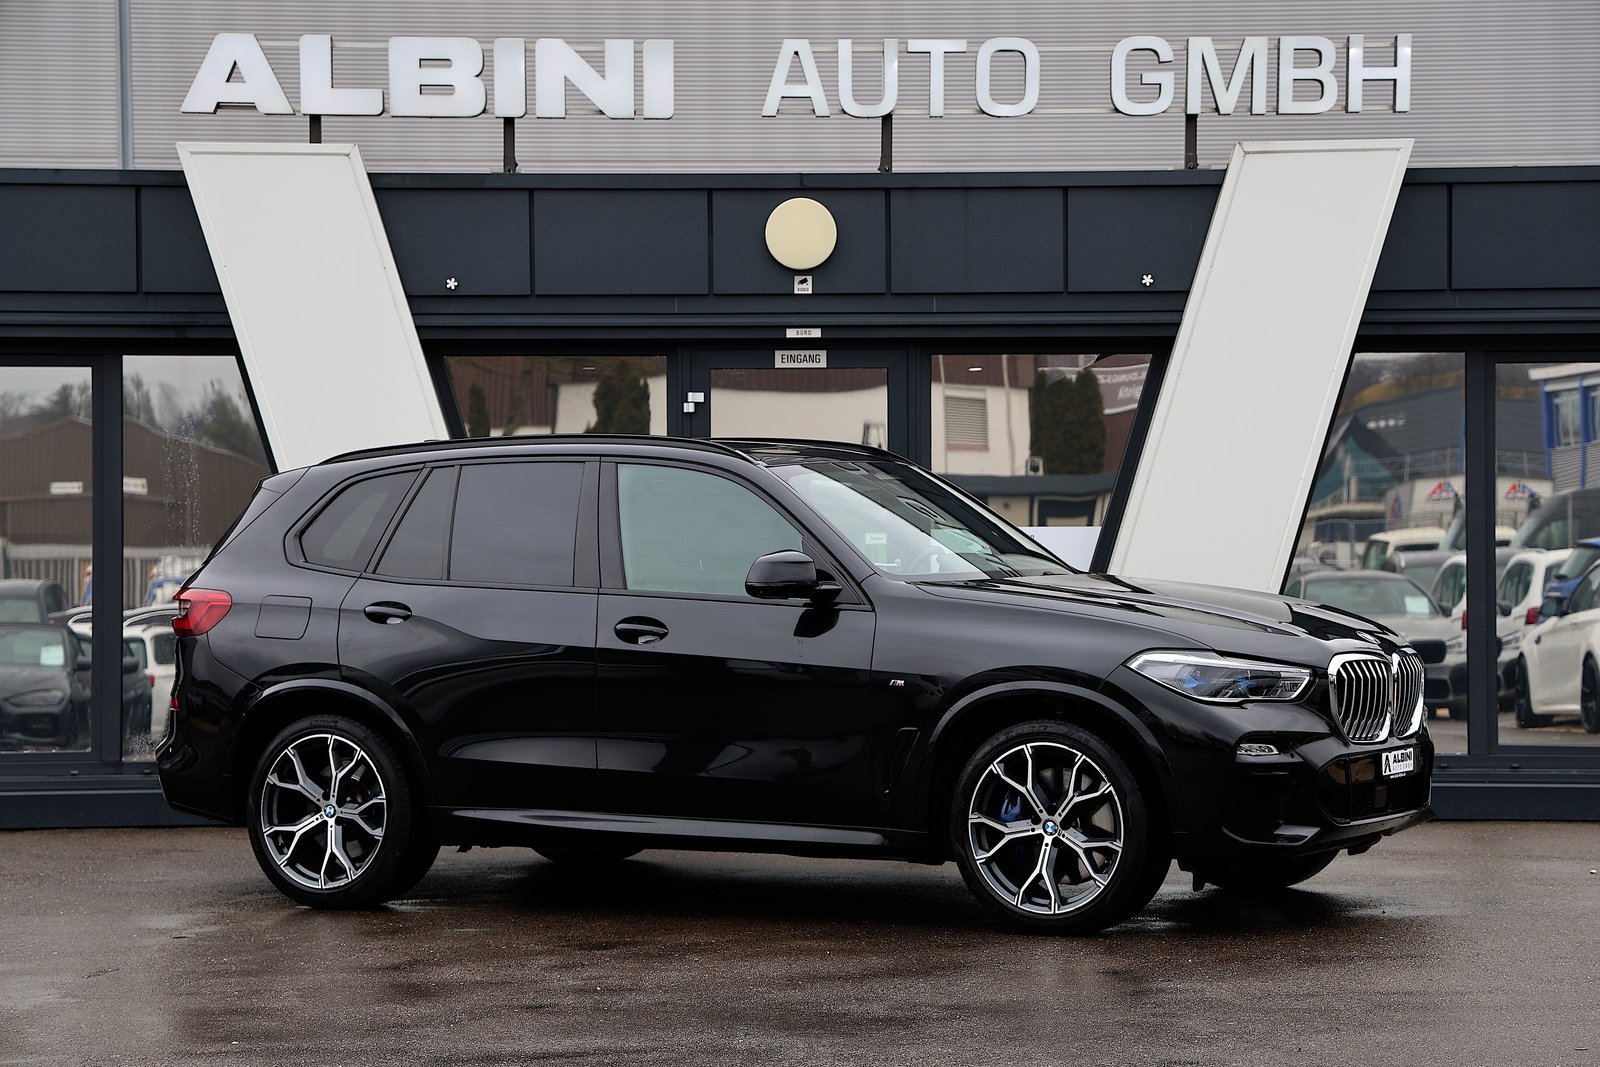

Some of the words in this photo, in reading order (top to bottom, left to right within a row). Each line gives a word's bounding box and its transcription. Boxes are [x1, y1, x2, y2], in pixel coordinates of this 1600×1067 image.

[180, 32, 675, 120] ALBINI
[761, 36, 1041, 118] AUTO
[1109, 33, 1413, 116] GMBH
[780, 353, 821, 364] EINGANG
[1392, 751, 1412, 764] ALBINI
